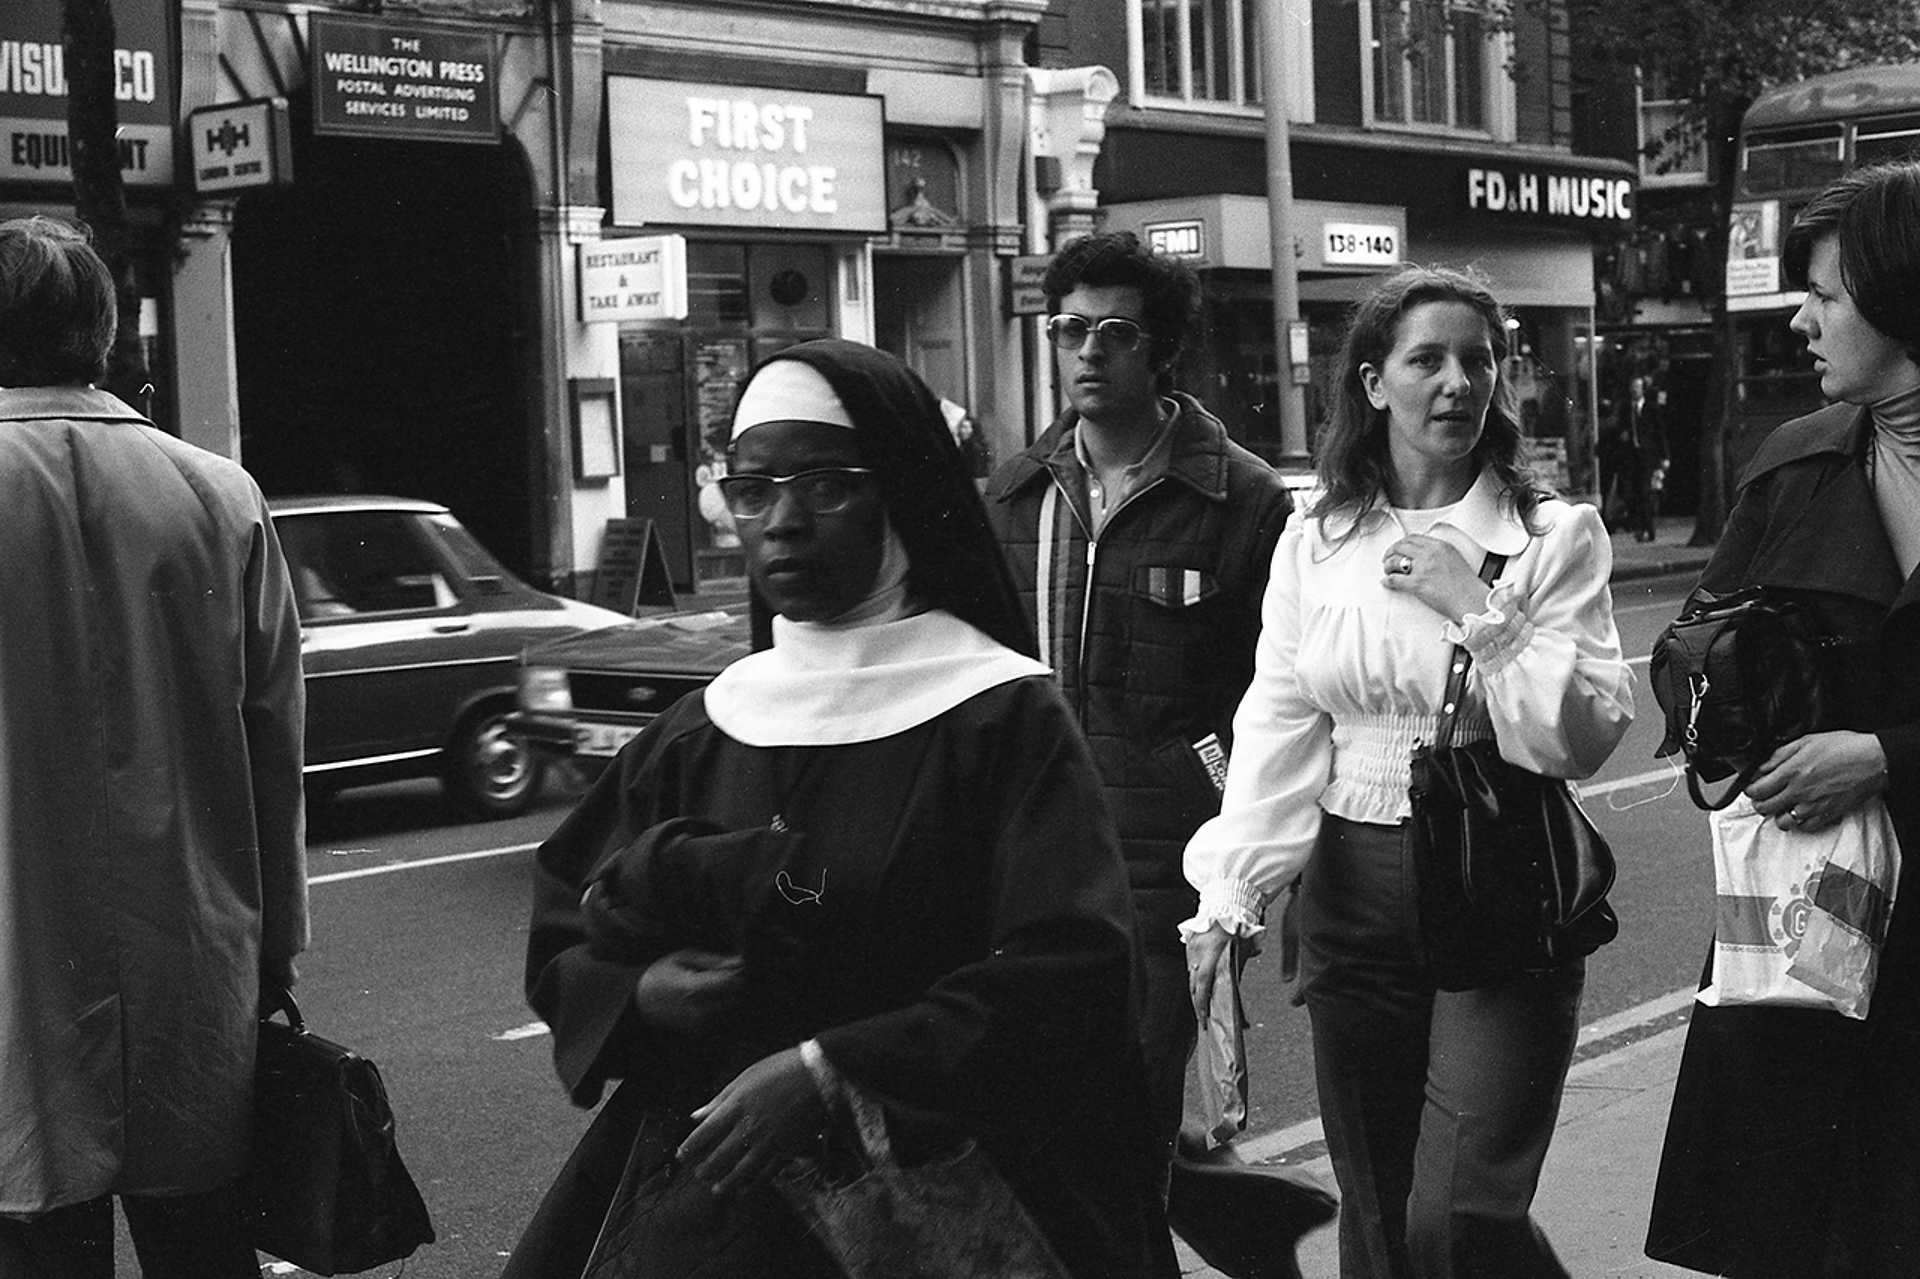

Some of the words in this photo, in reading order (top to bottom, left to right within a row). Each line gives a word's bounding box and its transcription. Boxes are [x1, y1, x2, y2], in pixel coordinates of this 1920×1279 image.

[391, 37, 421, 52] THE
[324, 52, 433, 78] WELLINGTON
[440, 61, 485, 83] PRESS
[337, 79, 387, 96] POSTAL
[394, 83, 476, 102] ADVERTISING
[345, 100, 406, 117] SERVICES
[415, 105, 469, 121] LIMITED
[687, 97, 814, 153] FIRST
[11, 132, 149, 170] EQUINT
[669, 158, 838, 213] CHOICE
[1548, 174, 1632, 220] MUSIC
[1150, 227, 1198, 254] EMI
[1329, 234, 1393, 254] 138-140
[585, 250, 660, 269] RESTAURANT
[619, 274, 628, 288] &
[590, 294, 618, 309] TAKE
[626, 292, 660, 307] AWAY
